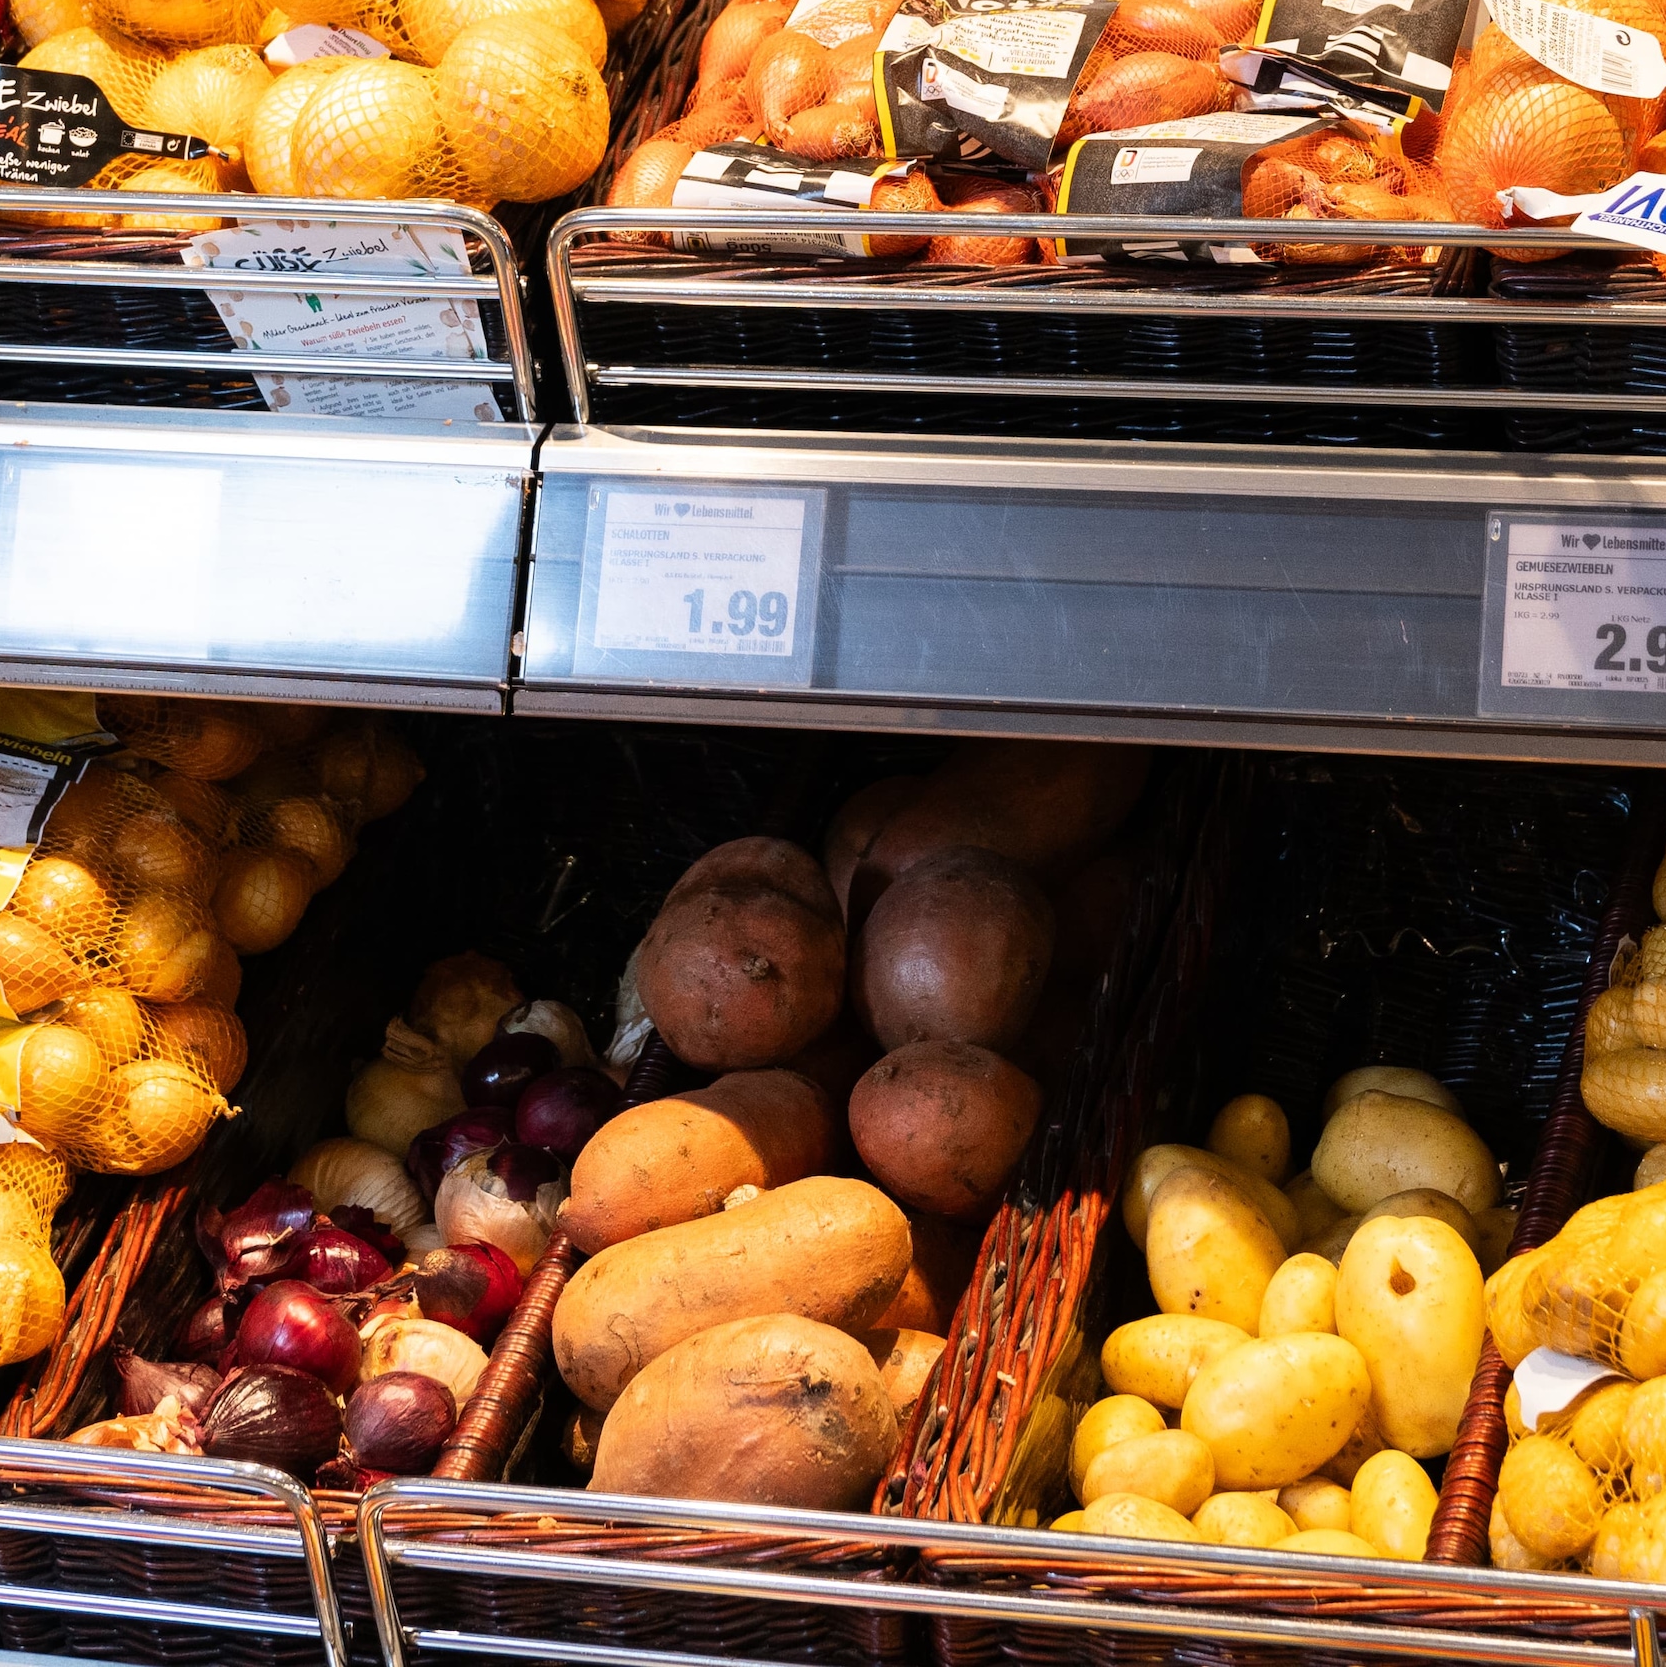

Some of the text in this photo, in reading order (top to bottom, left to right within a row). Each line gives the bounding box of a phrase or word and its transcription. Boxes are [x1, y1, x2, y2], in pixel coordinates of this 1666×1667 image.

[1002, 56, 1056, 65] VERWENDBAR
[1010, 49, 1050, 59] VIELSEITIG
[22, 91, 97, 117] Zwiebel
[26, 158, 71, 174] weniger
[287, 318, 329, 333] Geschmack
[301, 335, 328, 346] Warum
[347, 322, 381, 337] Zwiebeln
[383, 316, 407, 329] essen?
[655, 503, 670, 516] Wir
[611, 529, 670, 541] SCHALOTTEN
[1561, 534, 1579, 548] Wir
[609, 550, 691, 560] URSPRUNGSLAND
[703, 552, 766, 563] VERPACKUNG
[609, 558, 643, 567] KLASSE
[1516, 561, 1614, 575] GEMUESEZWIEBELN
[1515, 583, 1603, 594] URSPRUNGSLAND
[1605, 585, 1614, 594] S.
[1514, 592, 1551, 601] KLASSE
[683, 588, 789, 637] 1.99
[1540, 612, 1560, 620] 2.99
